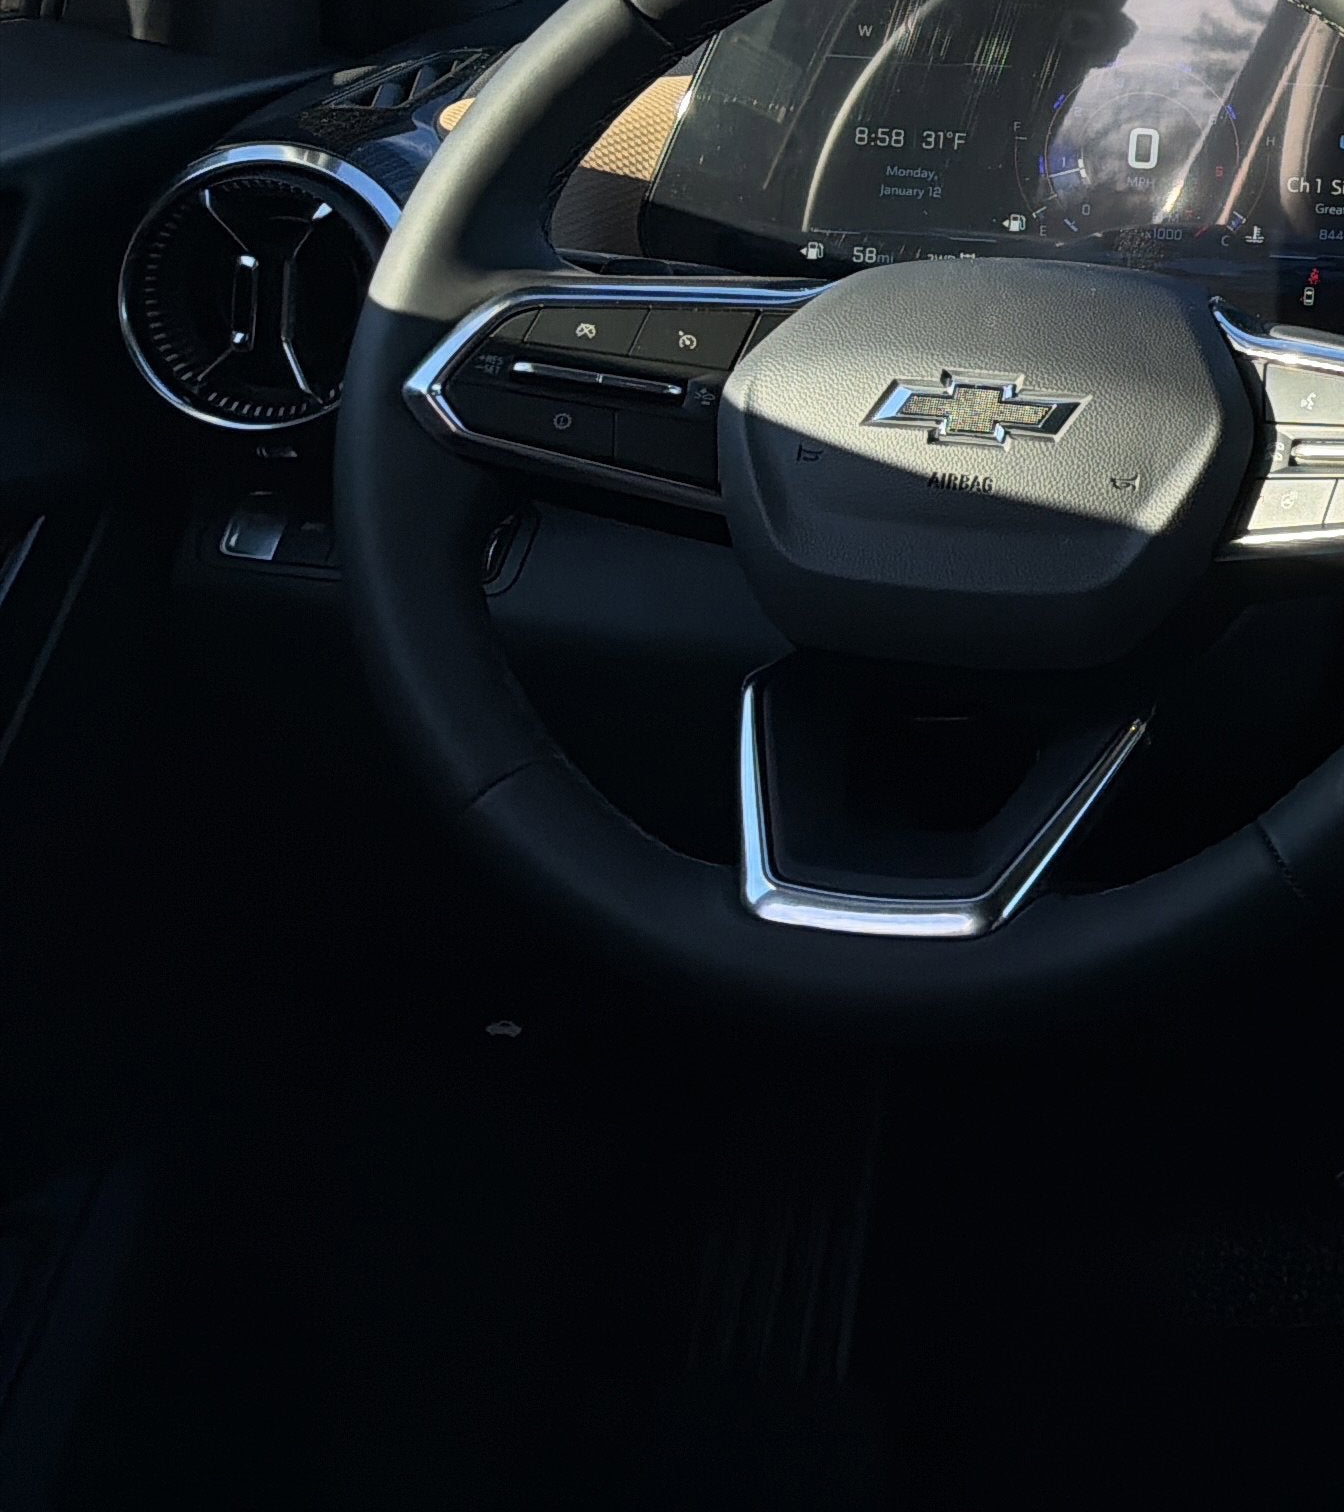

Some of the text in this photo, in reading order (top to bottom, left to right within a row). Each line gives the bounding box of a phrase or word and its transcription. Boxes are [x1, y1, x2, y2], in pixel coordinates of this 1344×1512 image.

[858, 24, 873, 37] W
[855, 126, 905, 148] 8:58
[1128, 128, 1160, 170] 0
[886, 165, 938, 181] Monday,
[880, 184, 942, 199] January 12
[1287, 177, 1310, 193] Ch
[1316, 178, 1322, 194] 1
[1221, 235, 1229, 246] C
[927, 471, 993, 493] AIRBAG
